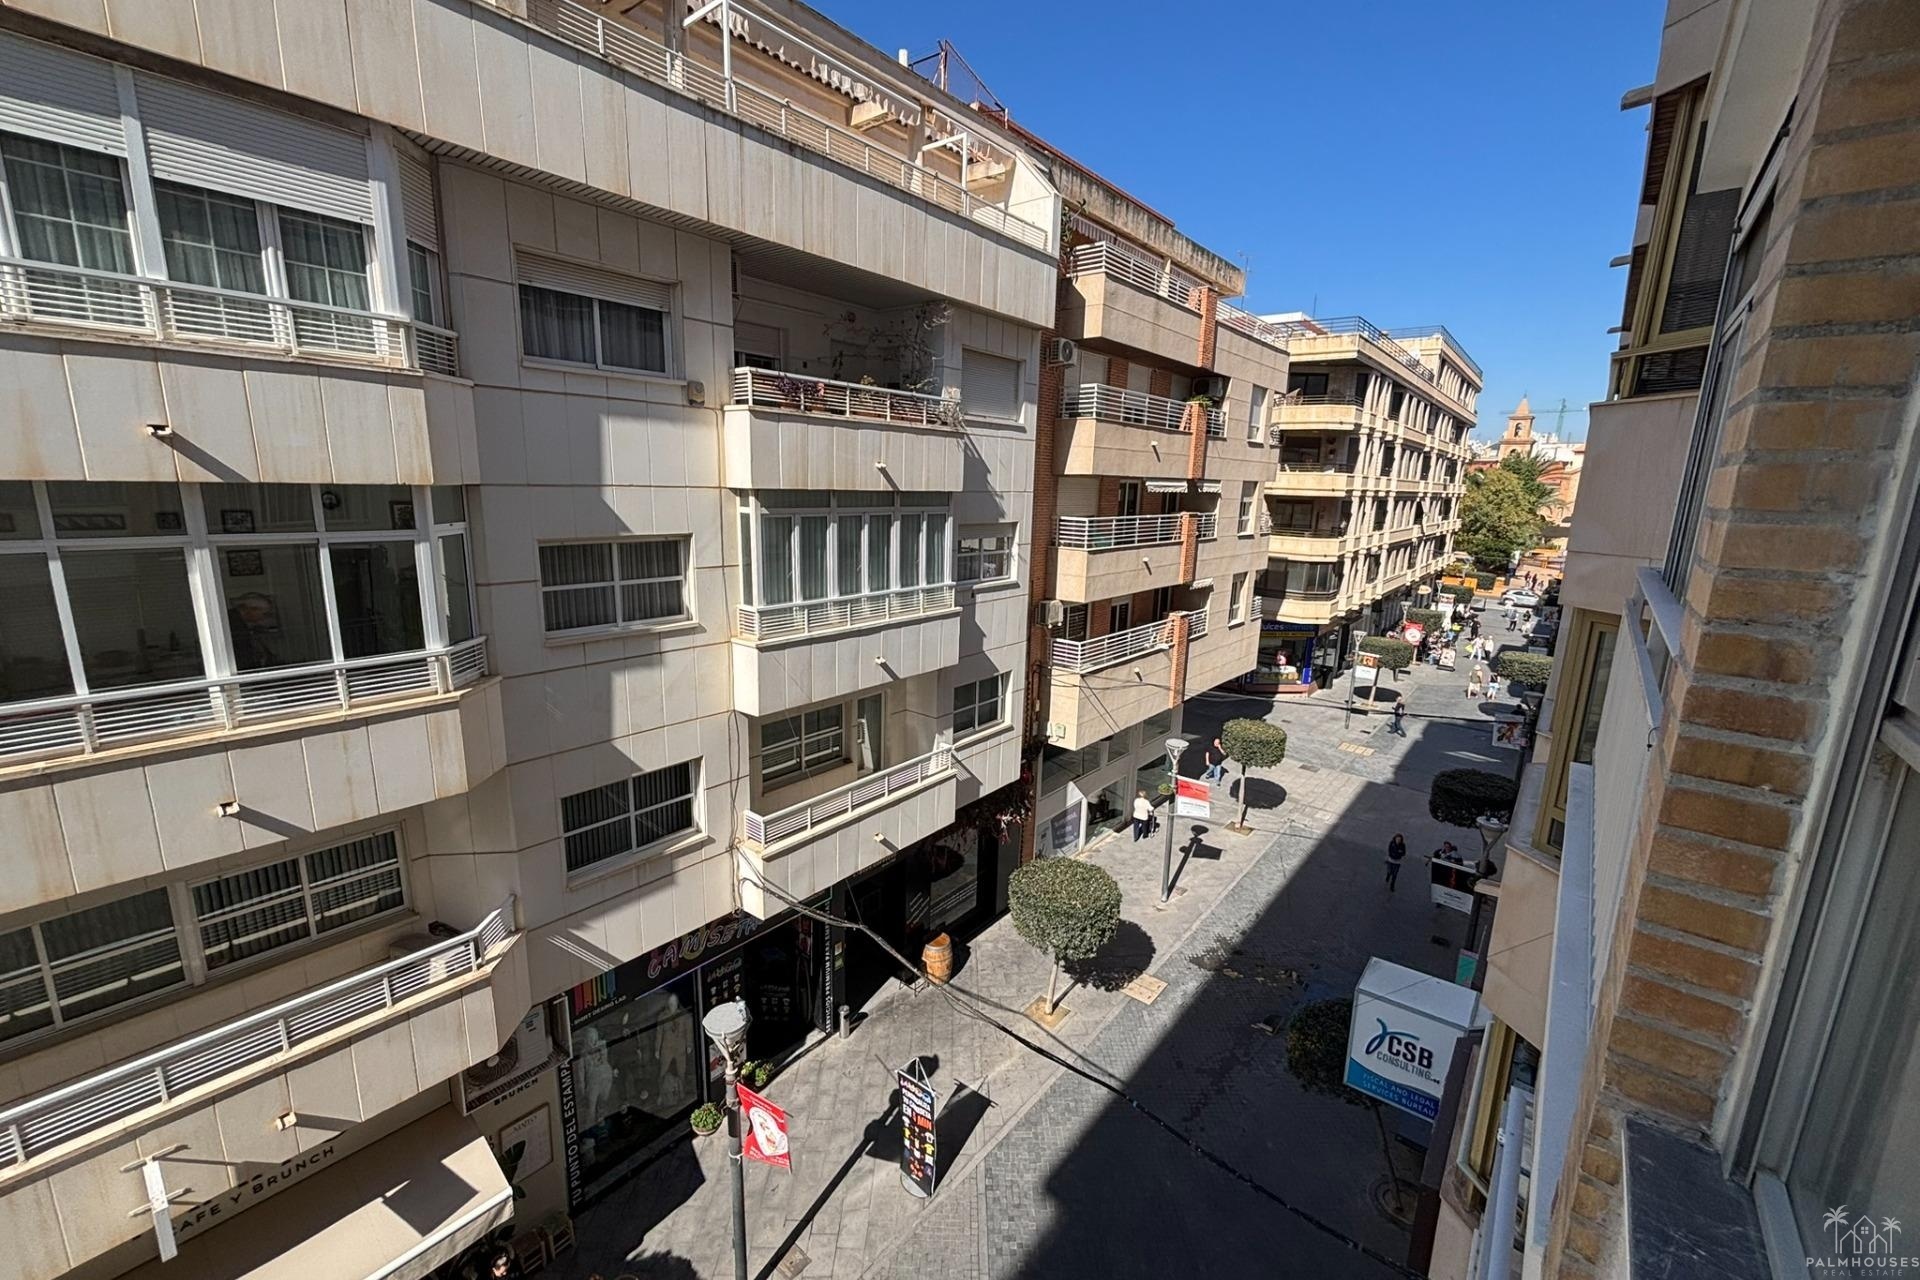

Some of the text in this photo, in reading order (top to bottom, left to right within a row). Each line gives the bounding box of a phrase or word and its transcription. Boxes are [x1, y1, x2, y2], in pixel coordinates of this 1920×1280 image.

[1387, 1035, 1434, 1070] CSB
[1362, 1072, 1436, 1110] FISCAL AND LEGAL
[1362, 1080, 1436, 1118] SERVICES BUREAU
[565, 1120, 578, 1145] DEL
[230, 1192, 244, 1206] Y
[251, 1144, 336, 1195] BRUNCH
[567, 1145, 582, 1189] PUNTO
[572, 1189, 583, 1207] TU
